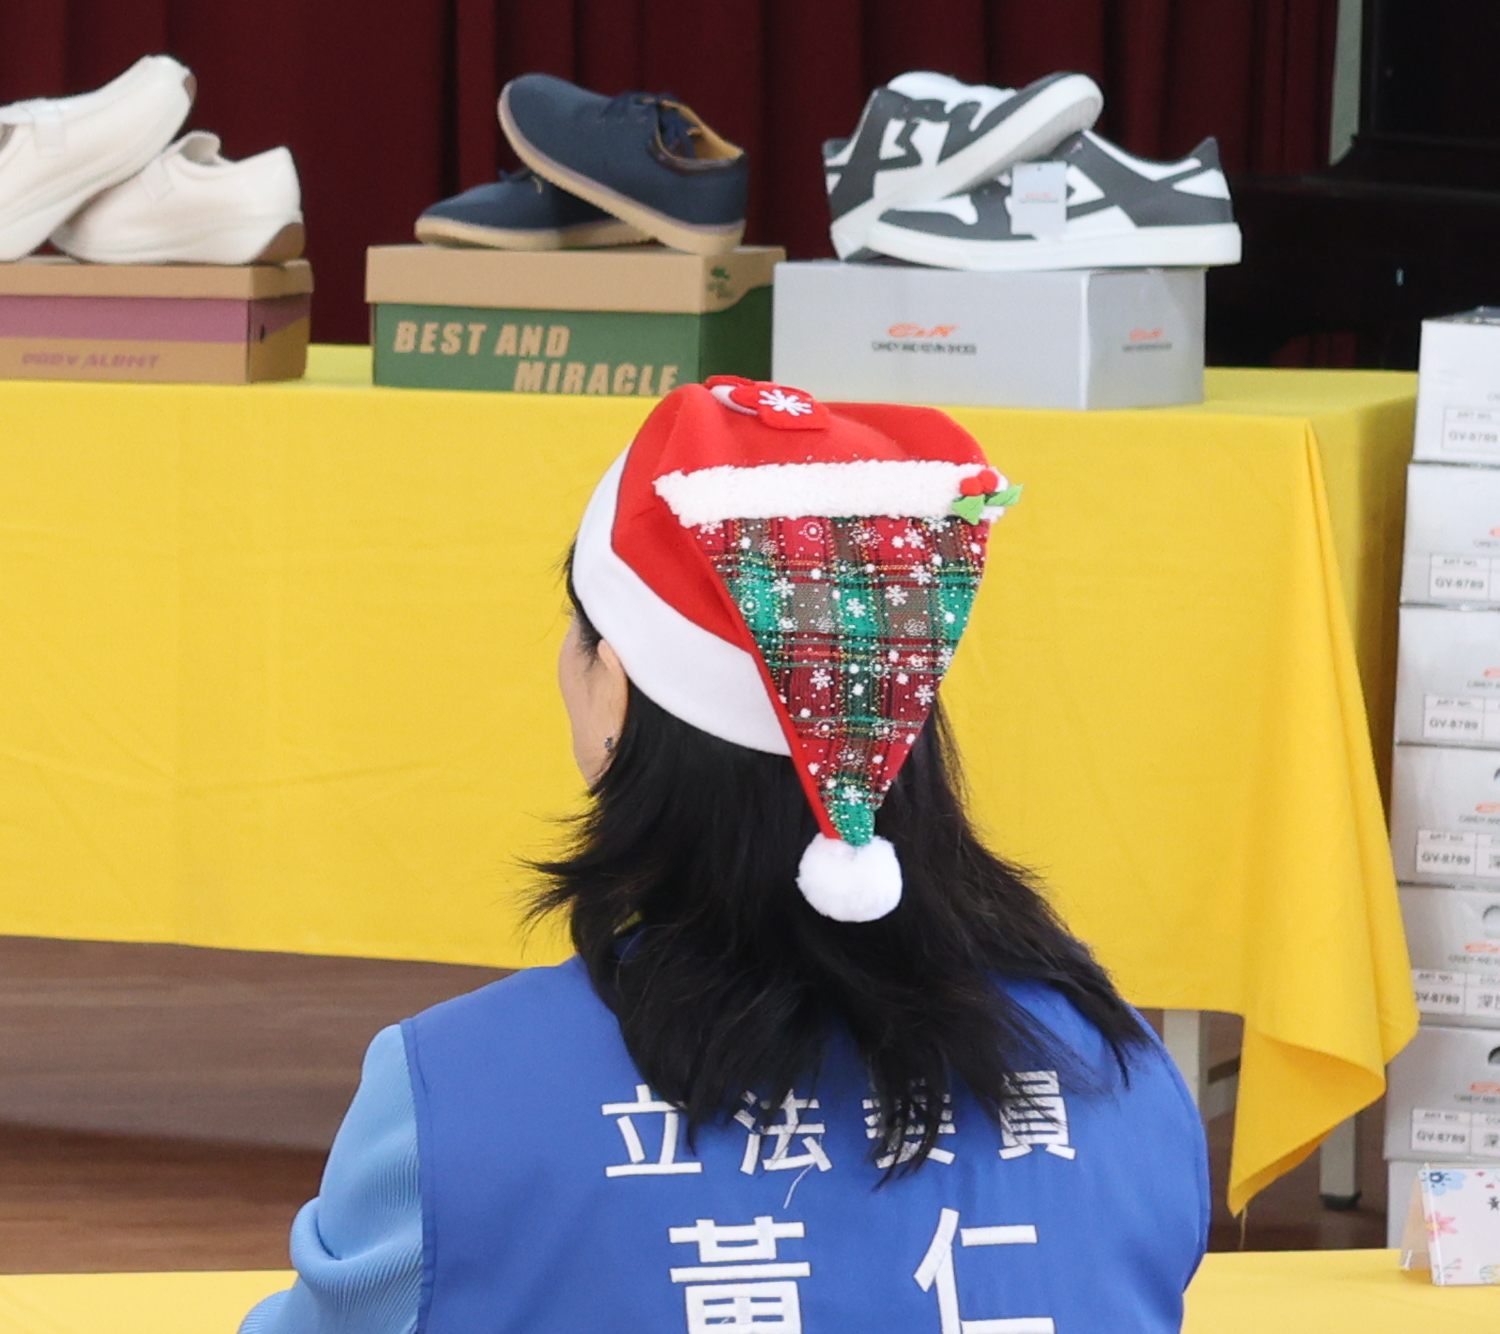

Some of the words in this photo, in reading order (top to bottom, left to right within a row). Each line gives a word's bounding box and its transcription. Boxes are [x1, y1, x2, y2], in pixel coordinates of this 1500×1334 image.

[393, 321, 487, 356] BEST
[494, 323, 571, 358] AND
[513, 361, 679, 397] MIRACLE
